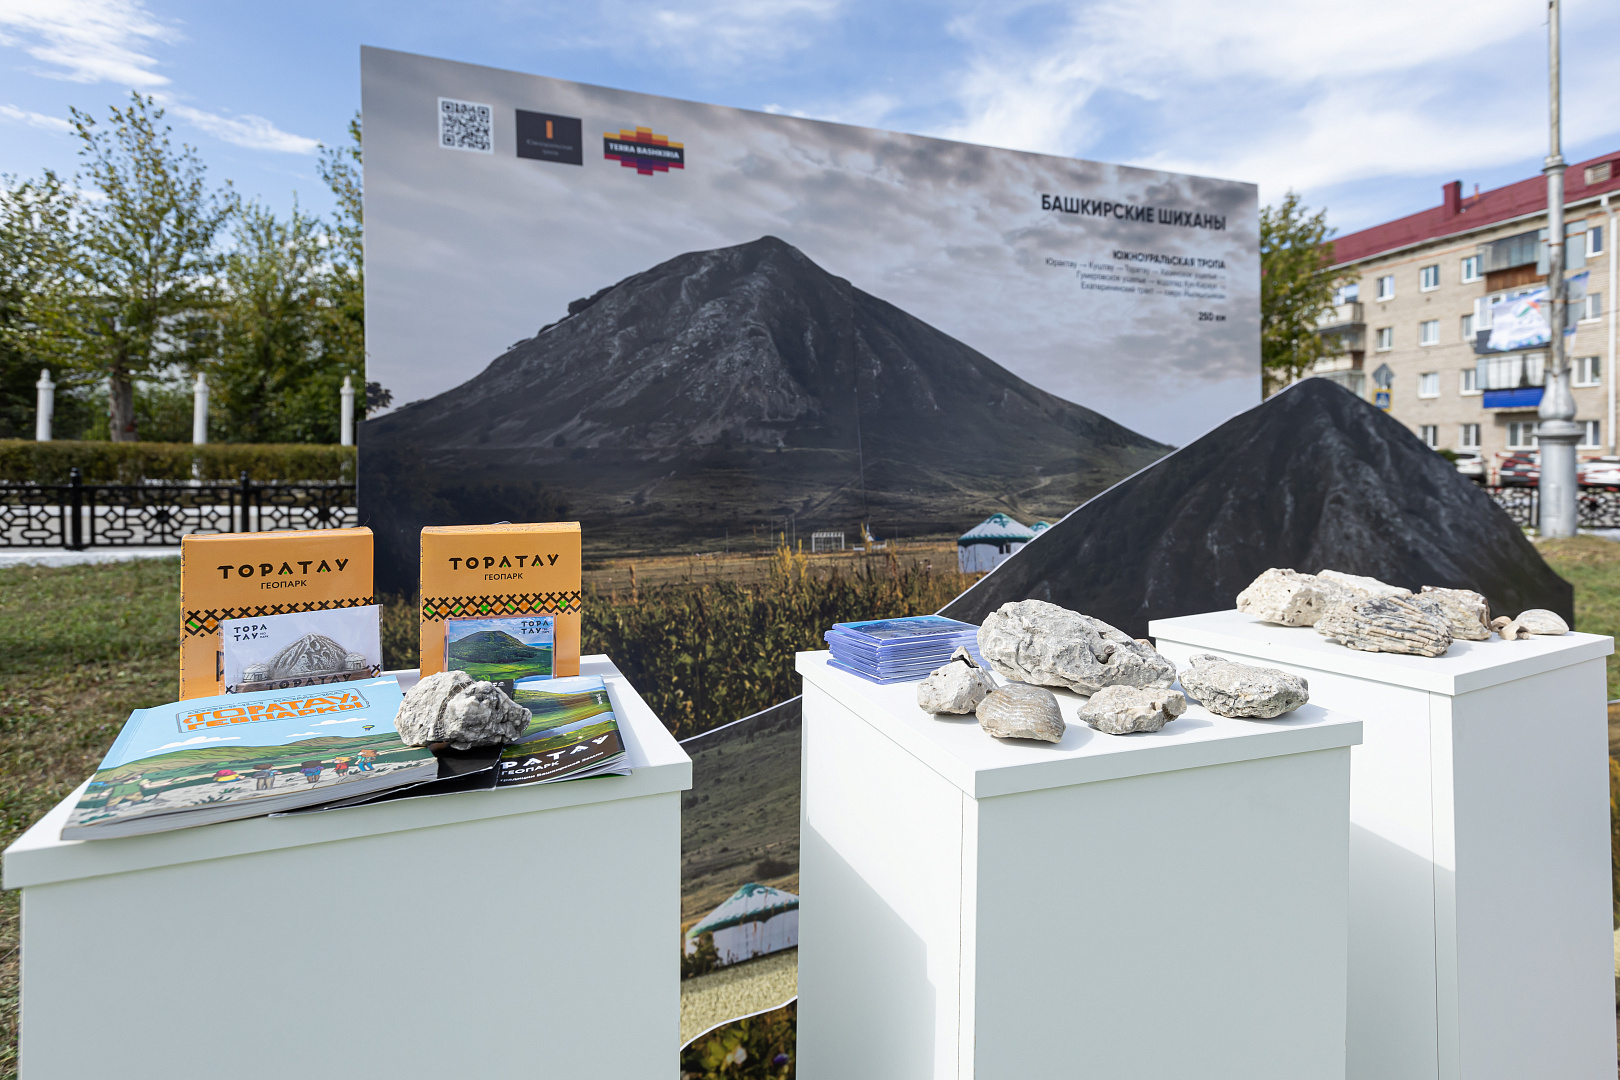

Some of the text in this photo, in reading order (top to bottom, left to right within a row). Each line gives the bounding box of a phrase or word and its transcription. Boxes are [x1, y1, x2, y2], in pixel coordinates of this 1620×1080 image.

[609, 142, 680, 159] TERRA BASHKIRIA
[1041, 193, 1226, 231] БАШКИРСКИЕ ШИХАНЫ
[1112, 250, 1226, 269] ЮЖНОУРАЛЬСКАЯ ТРОПА
[1198, 311, 1214, 321] 250
[217, 558, 349, 579] ТОРАТАУ
[448, 553, 559, 570] ТОРАТАУ
[261, 579, 307, 590] ГЕОПАРК
[484, 572, 523, 581] ГЕОПАРК
[233, 624, 267, 633] ТОРА
[233, 632, 258, 641] ТАУ
[266, 673, 352, 690] ТОРАТАУ
[187, 701, 364, 731] ГЕОПАРКЫ
[500, 735, 609, 770] РАТАУ
[502, 761, 560, 776] ГЕОПАРК
